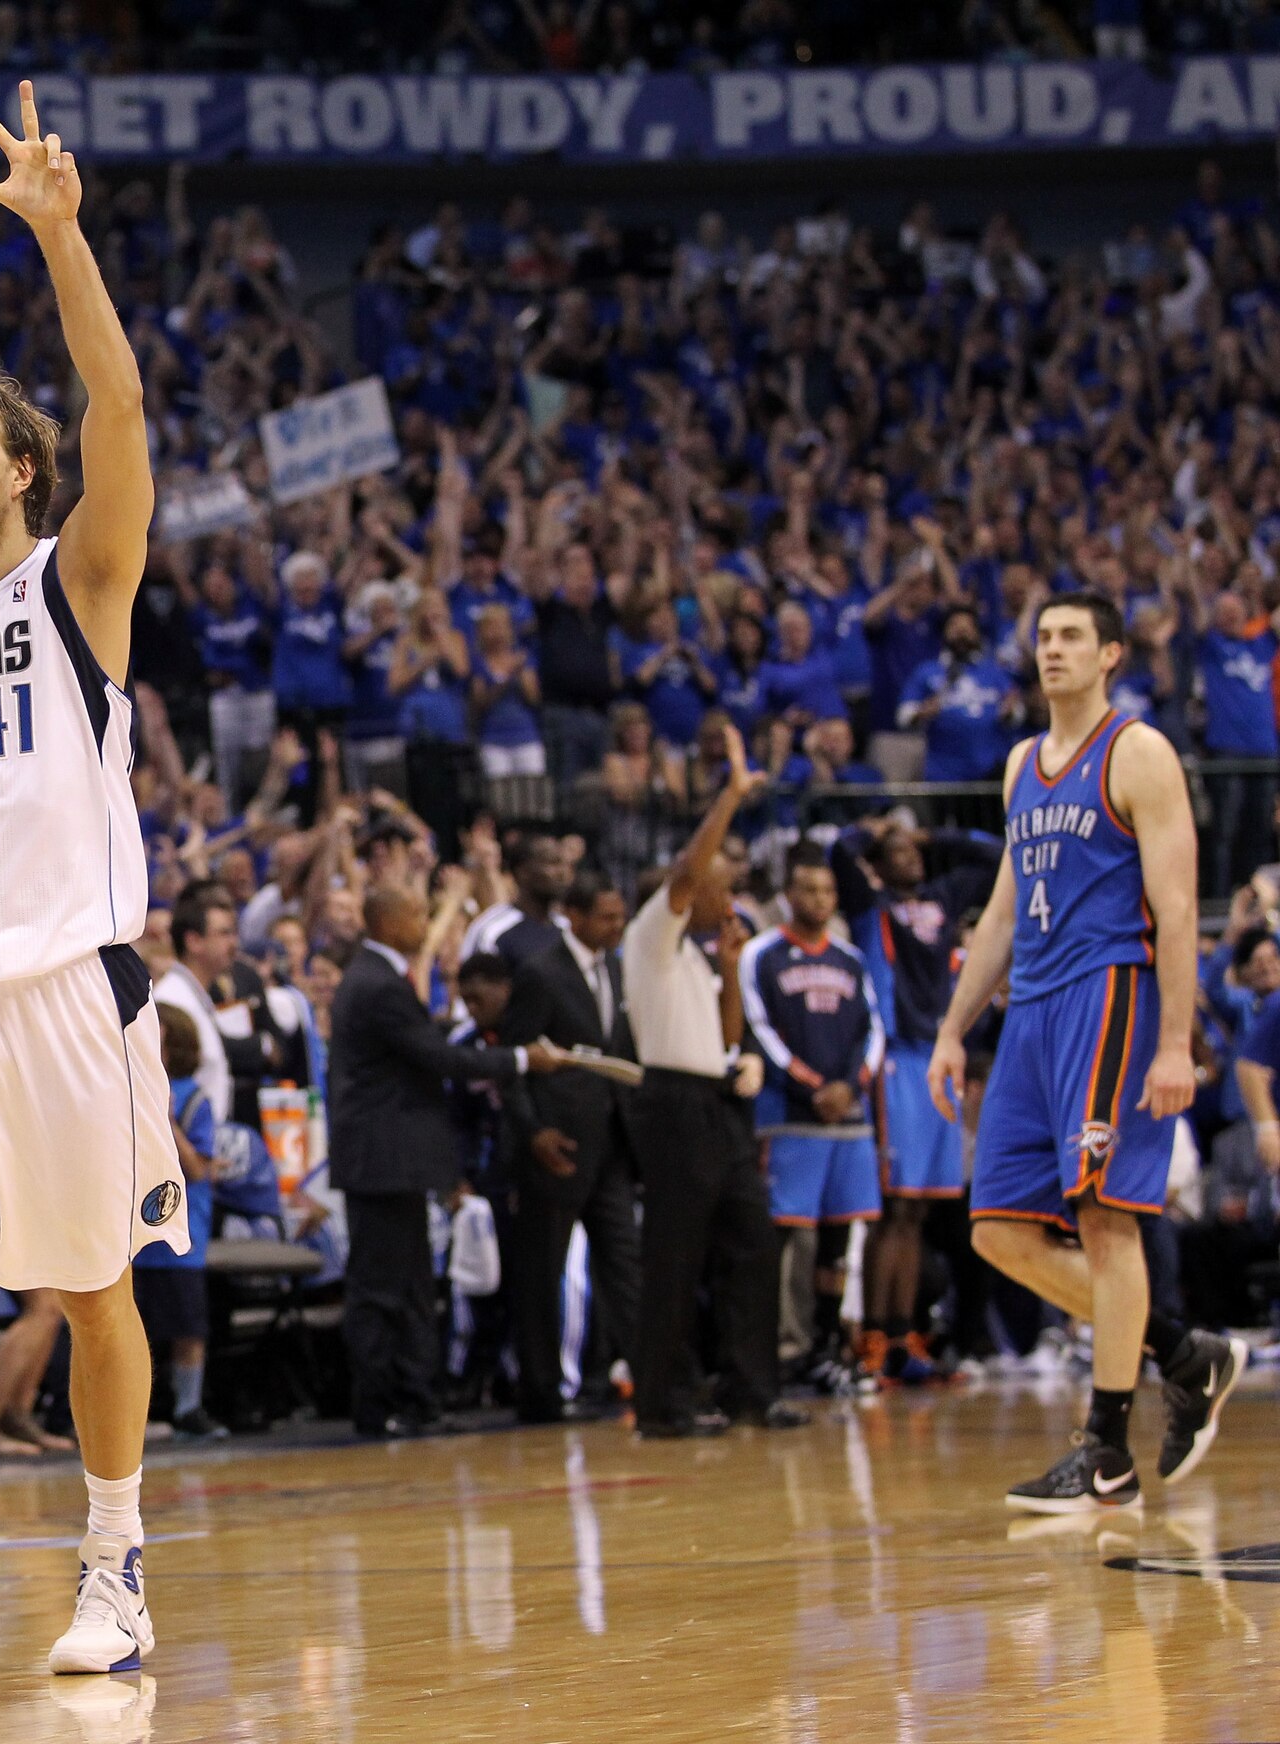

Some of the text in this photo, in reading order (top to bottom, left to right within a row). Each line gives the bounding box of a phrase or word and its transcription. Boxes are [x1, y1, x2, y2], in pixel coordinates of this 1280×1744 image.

[6, 73, 211, 152] GET
[244, 72, 675, 160] ROWDY,
[712, 62, 1131, 150] PROUD,
[1021, 841, 1061, 877] CITY
[1028, 878, 1052, 934] 4
